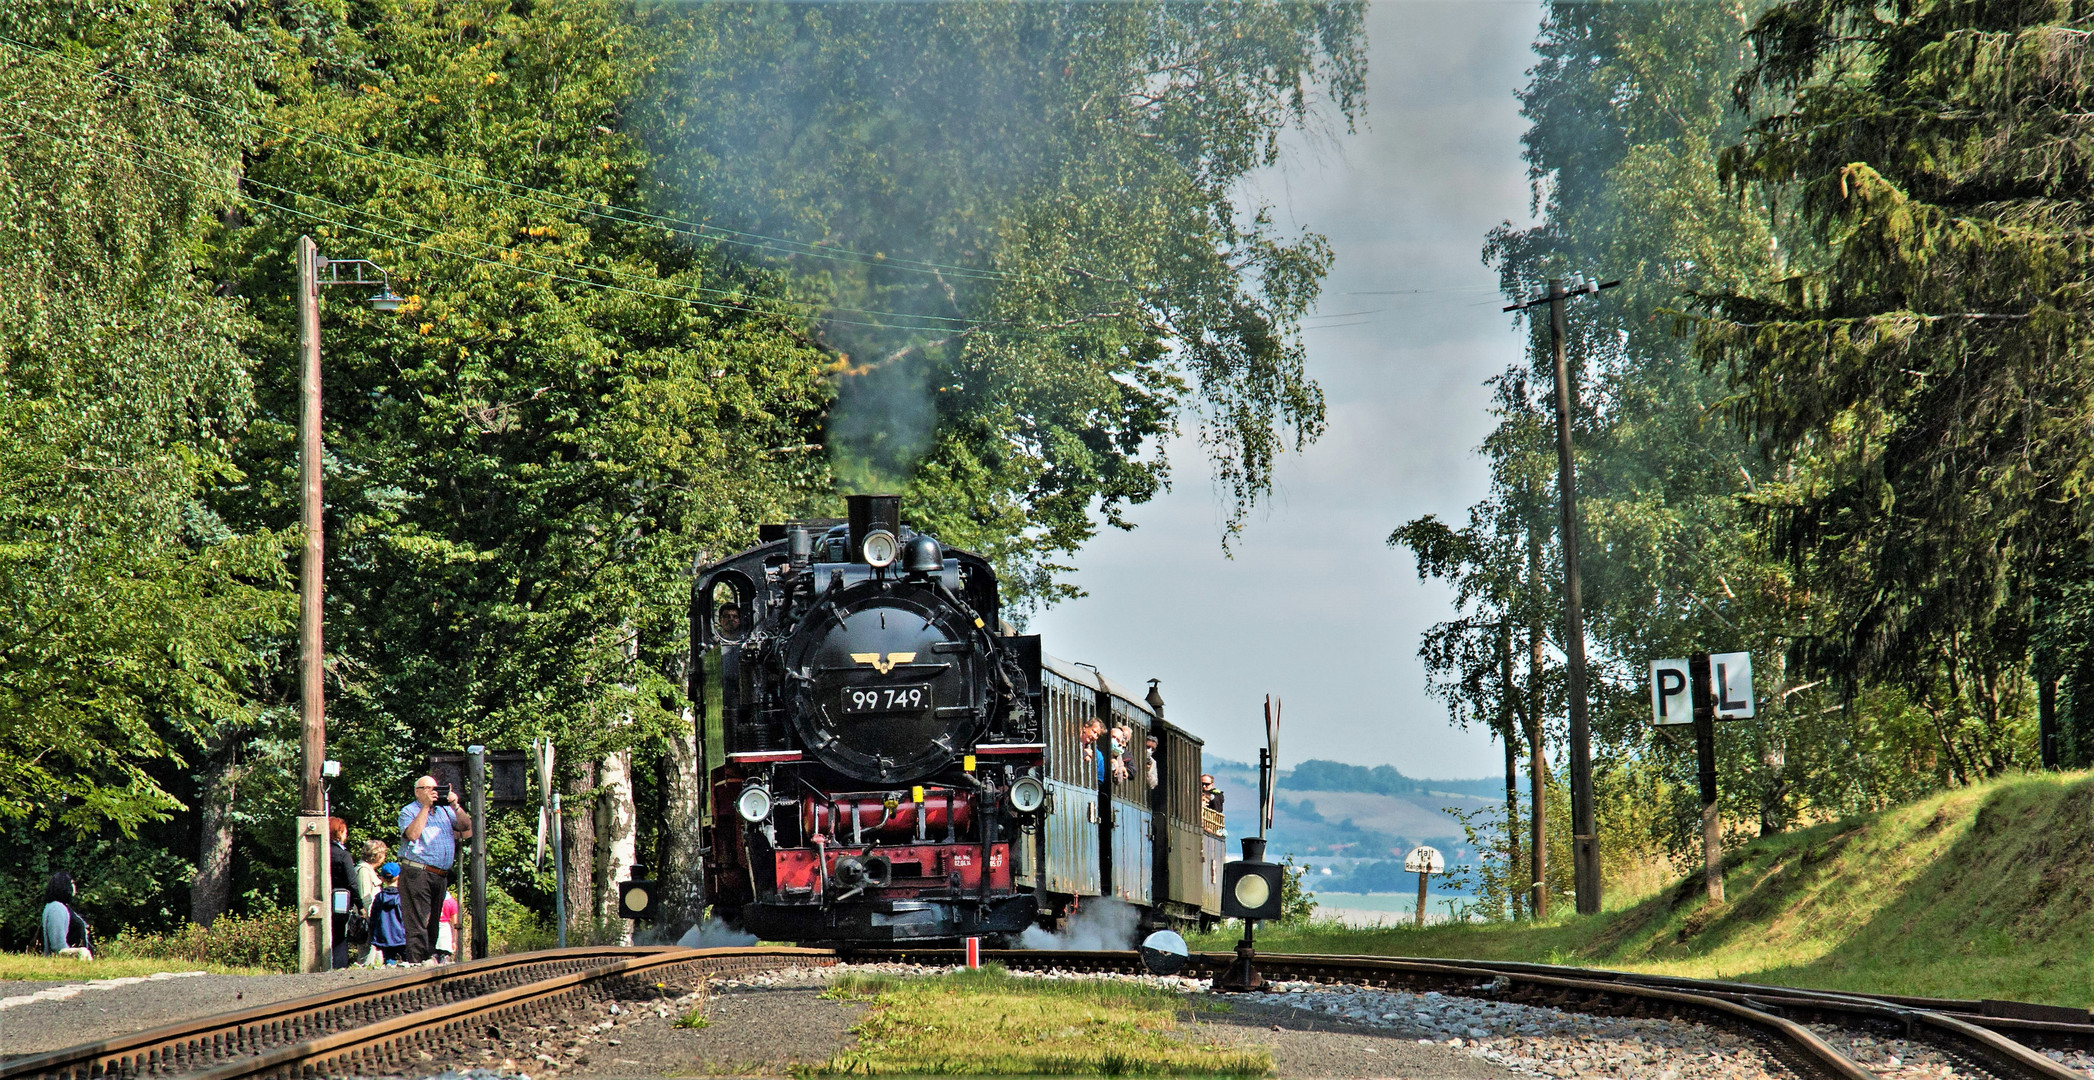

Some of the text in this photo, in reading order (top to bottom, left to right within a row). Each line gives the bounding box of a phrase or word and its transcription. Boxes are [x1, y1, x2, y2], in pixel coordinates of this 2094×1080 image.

[852, 689, 921, 709] 99 749
[1656, 668, 1686, 717] P
[1717, 663, 1747, 711] L
[1417, 848, 1434, 857] Halt
